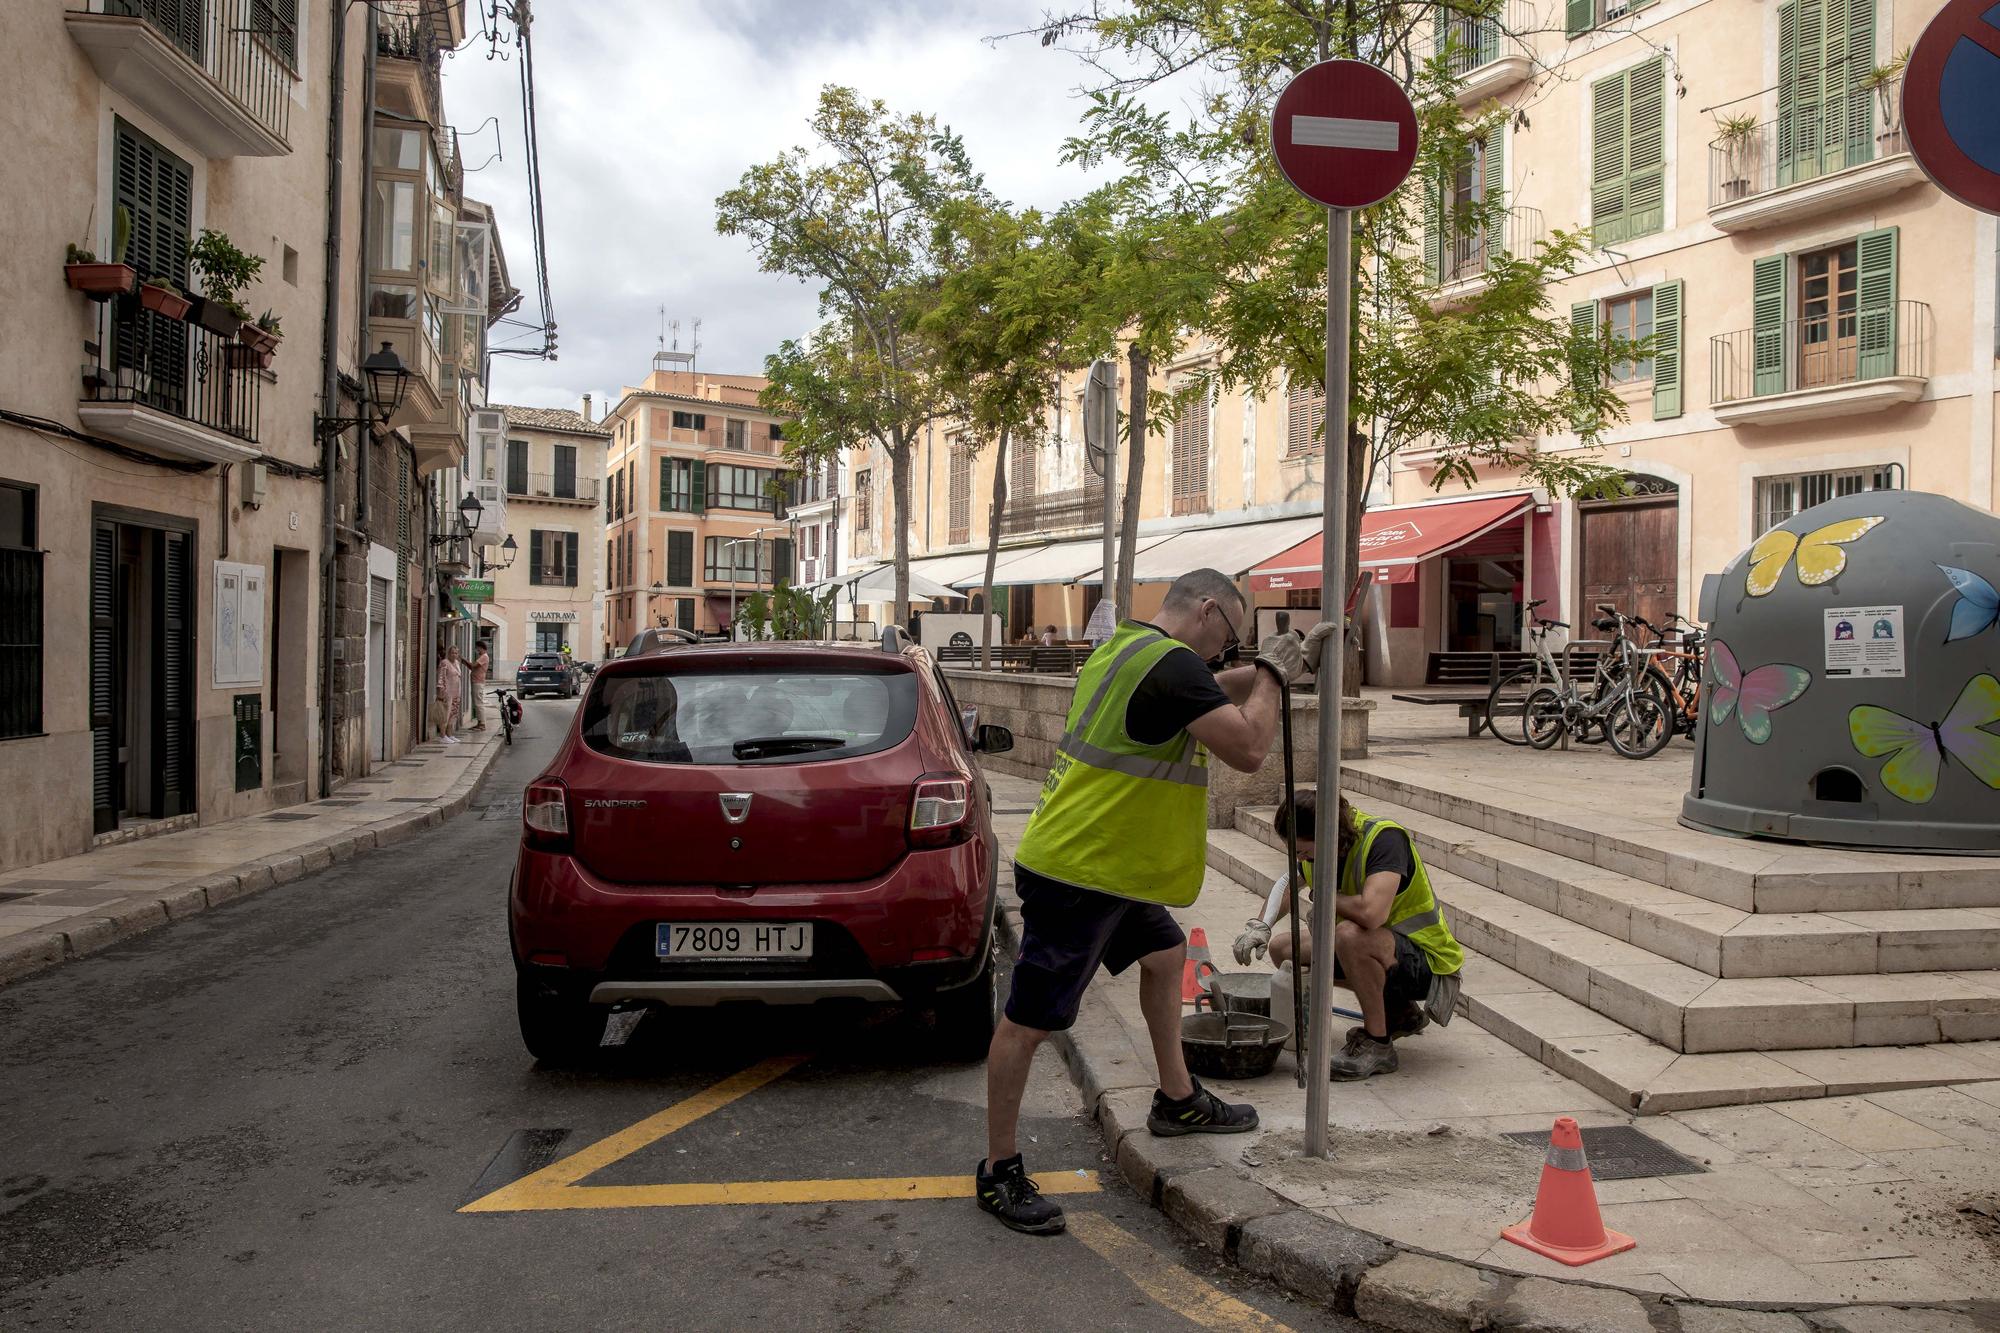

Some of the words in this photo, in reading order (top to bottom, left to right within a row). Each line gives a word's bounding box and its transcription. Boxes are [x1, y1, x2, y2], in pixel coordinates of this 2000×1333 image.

[530, 611, 576, 620] CALATRAVA
[661, 942, 667, 950] E
[675, 927, 740, 952] 7809
[755, 927, 804, 952] HTJ
